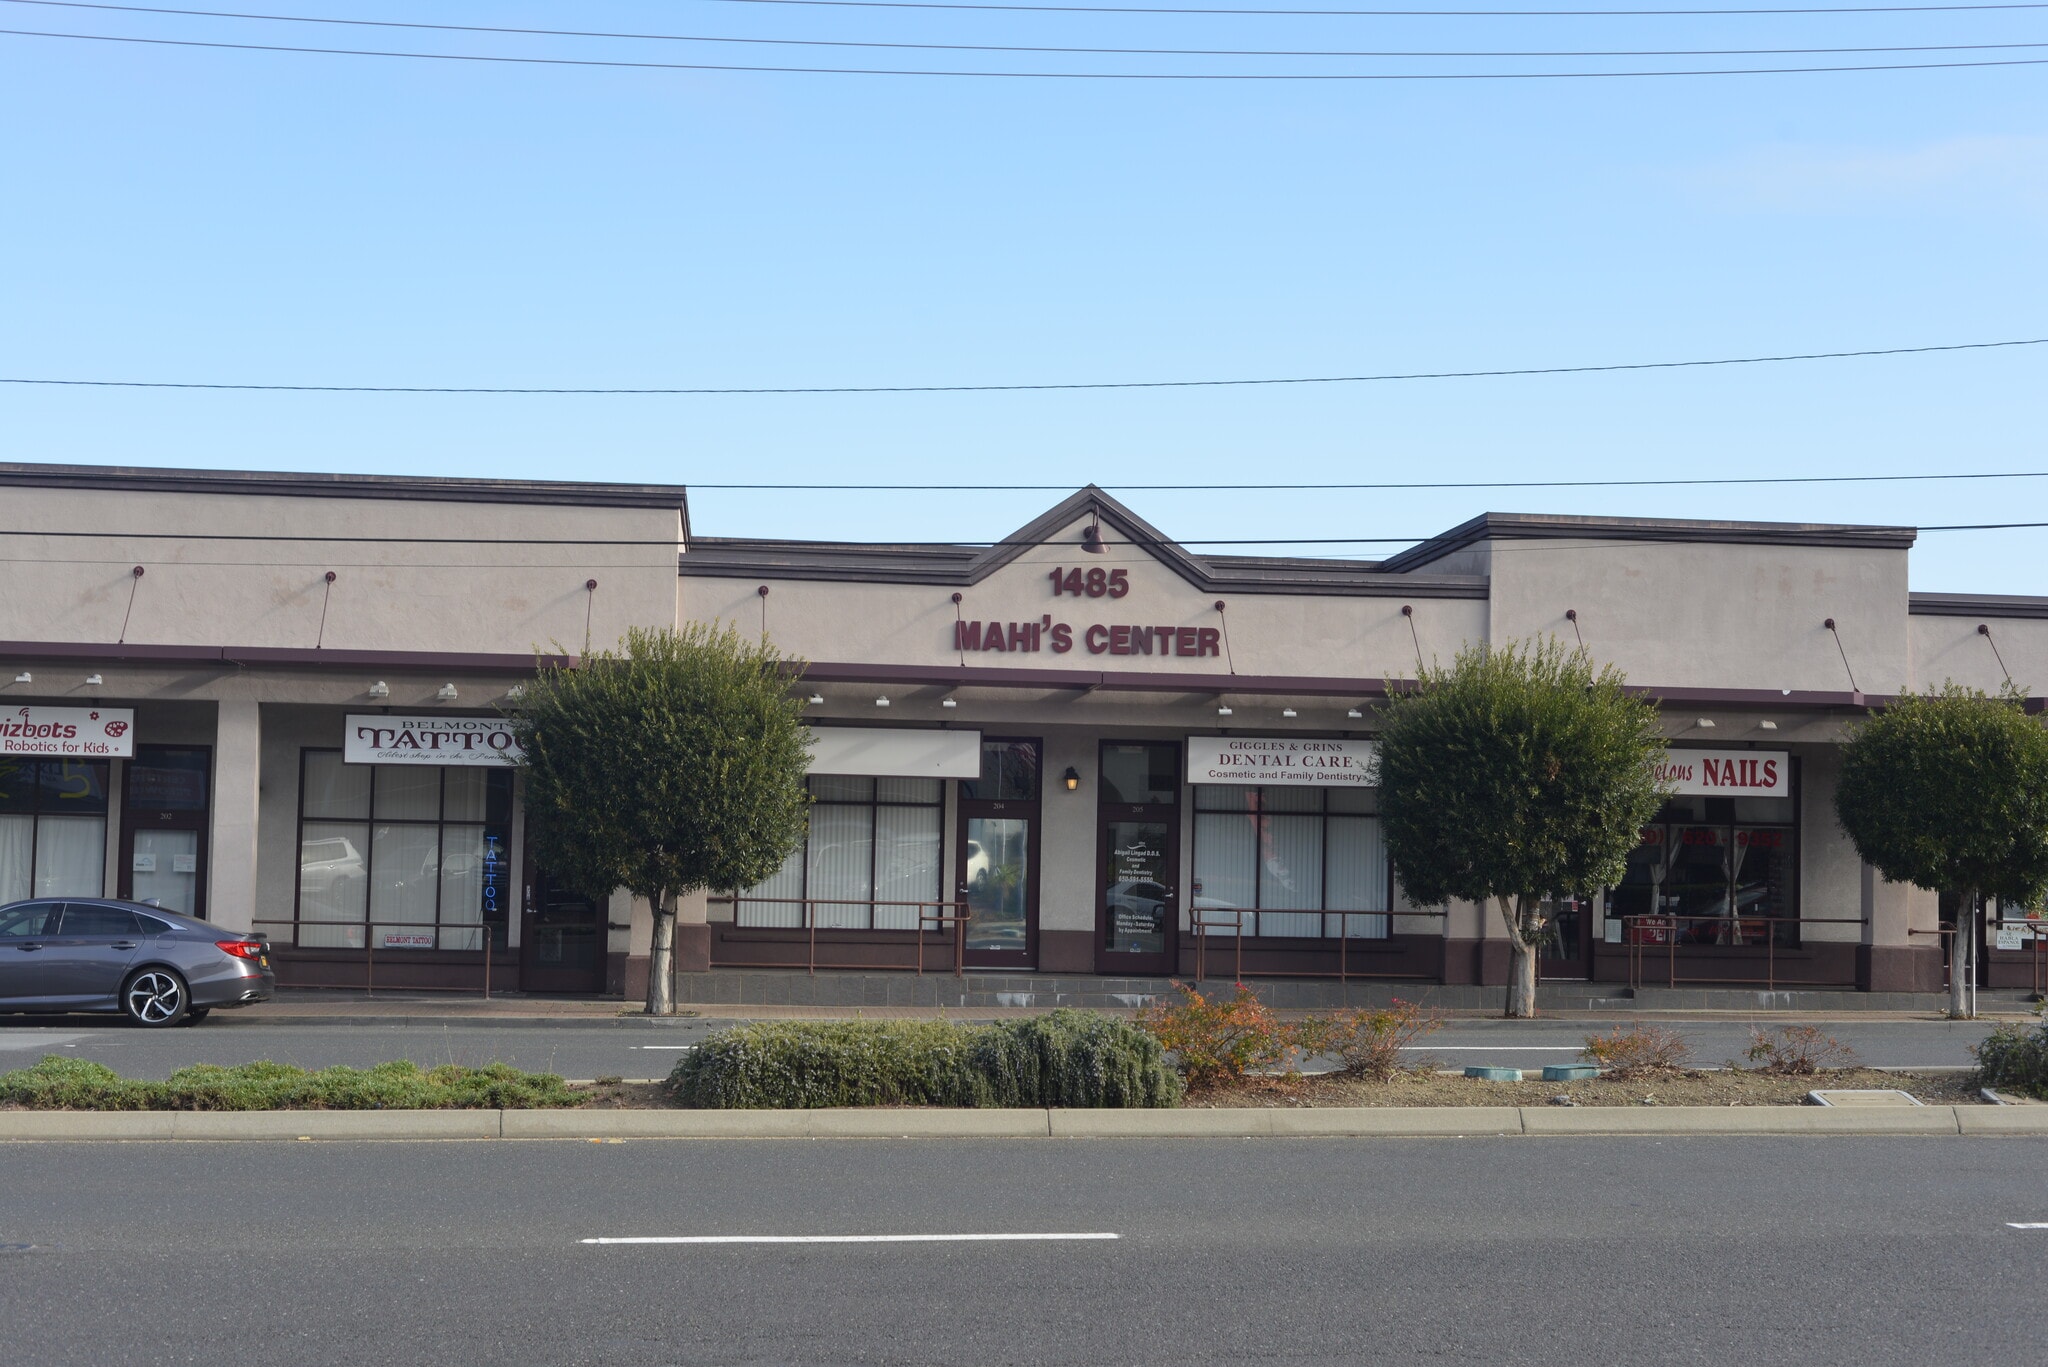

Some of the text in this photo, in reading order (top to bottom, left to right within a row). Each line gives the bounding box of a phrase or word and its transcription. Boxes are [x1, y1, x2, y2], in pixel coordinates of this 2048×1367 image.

[1049, 567, 1129, 598] 1485
[955, 614, 1221, 657] MAHI'S CENTER
[0, 717, 77, 738] izbots
[402, 721, 511, 730] BELMONT
[5, 740, 110, 754] Robotics for Kids
[1229, 741, 1343, 752] GIGGLES & GRINS
[409, 752, 431, 760] shop
[1218, 753, 1353, 768] DENTAL CARE
[1208, 769, 1363, 783] Cosmetic and Family Dentistry
[1652, 758, 1778, 788] elous NAILS
[412, 936, 432, 944] TATTOO
